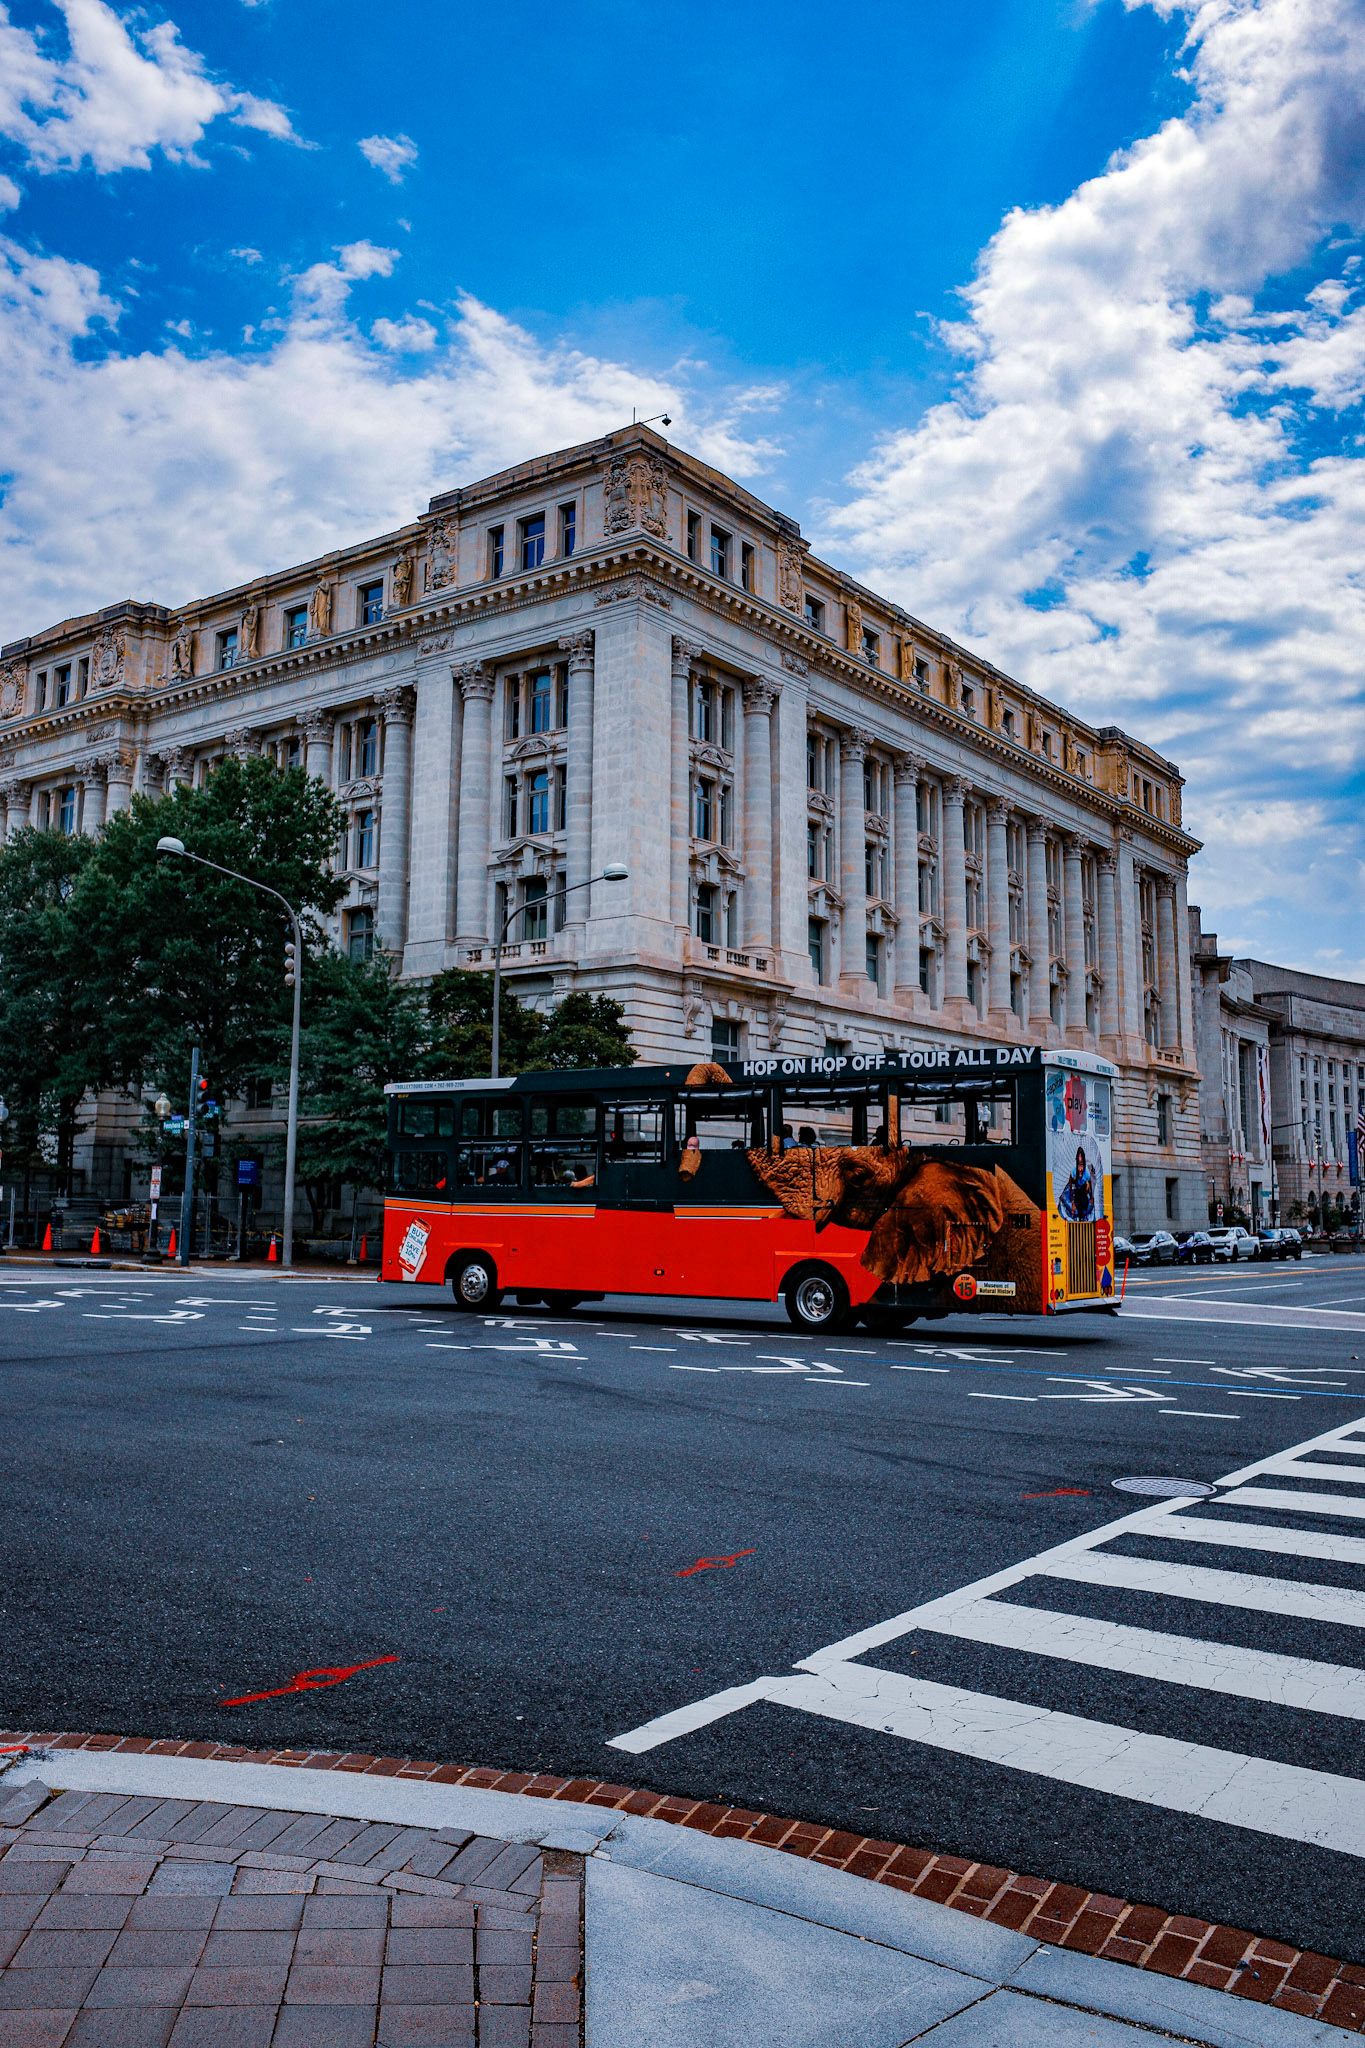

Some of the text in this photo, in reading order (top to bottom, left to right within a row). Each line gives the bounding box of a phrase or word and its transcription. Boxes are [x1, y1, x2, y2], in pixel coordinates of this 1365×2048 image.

[743, 1061, 778, 1076] HOP
[781, 1059, 806, 1075] ON
[811, 1057, 847, 1073] HOP
[851, 1055, 886, 1071] OFF
[898, 1051, 950, 1069] TOUR
[955, 1049, 990, 1066] ALL
[996, 1047, 1035, 1064] DAY
[1067, 1093, 1083, 1115] play
[411, 1227, 425, 1240] BUY
[405, 1248, 416, 1260] 10%
[406, 1241, 420, 1255] SAVE
[958, 1282, 972, 1297] 15
[997, 1288, 1014, 1296] History
